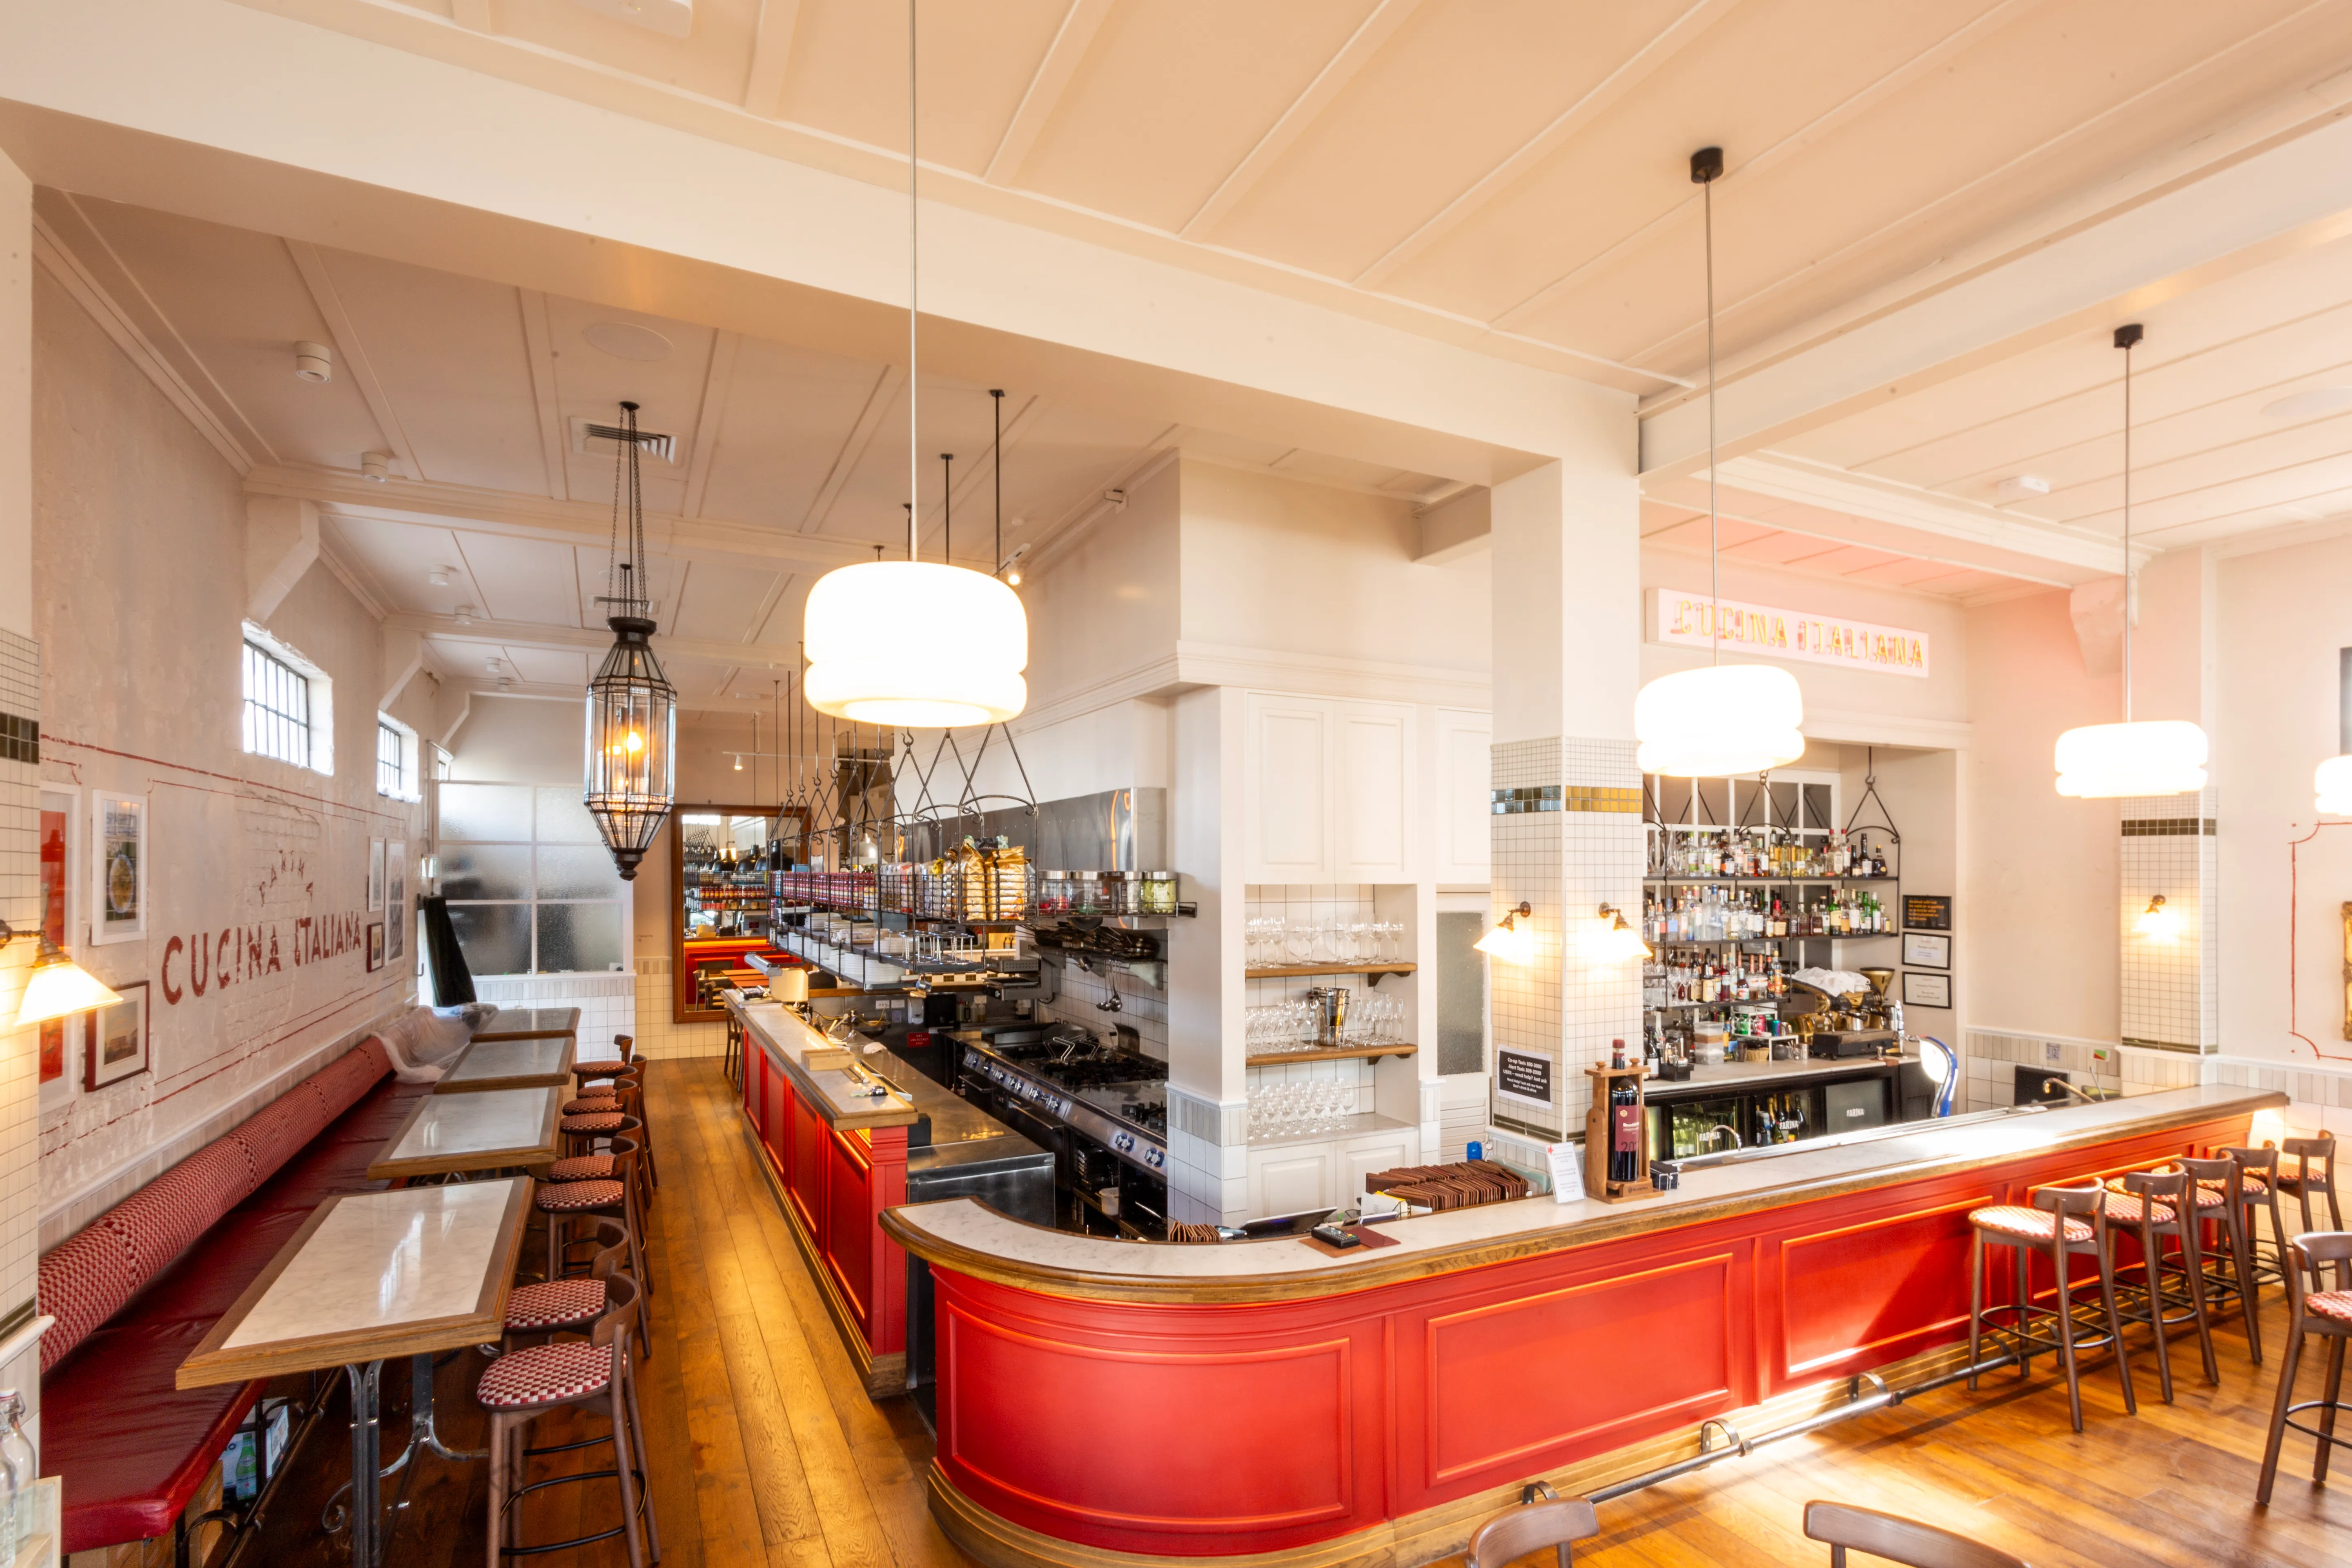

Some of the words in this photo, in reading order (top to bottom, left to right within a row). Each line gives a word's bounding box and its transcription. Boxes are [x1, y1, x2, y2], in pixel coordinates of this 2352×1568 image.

[1679, 599, 1788, 649] CUCINA
[1802, 620, 1924, 668] ITALIANA
[161, 924, 281, 1005] CUCINA
[294, 911, 361, 967] ITALIANA
[1846, 1108, 1865, 1118] FARINA
[1779, 1120, 1799, 1130] FARINA
[1699, 1131, 1721, 1142] FARNA
